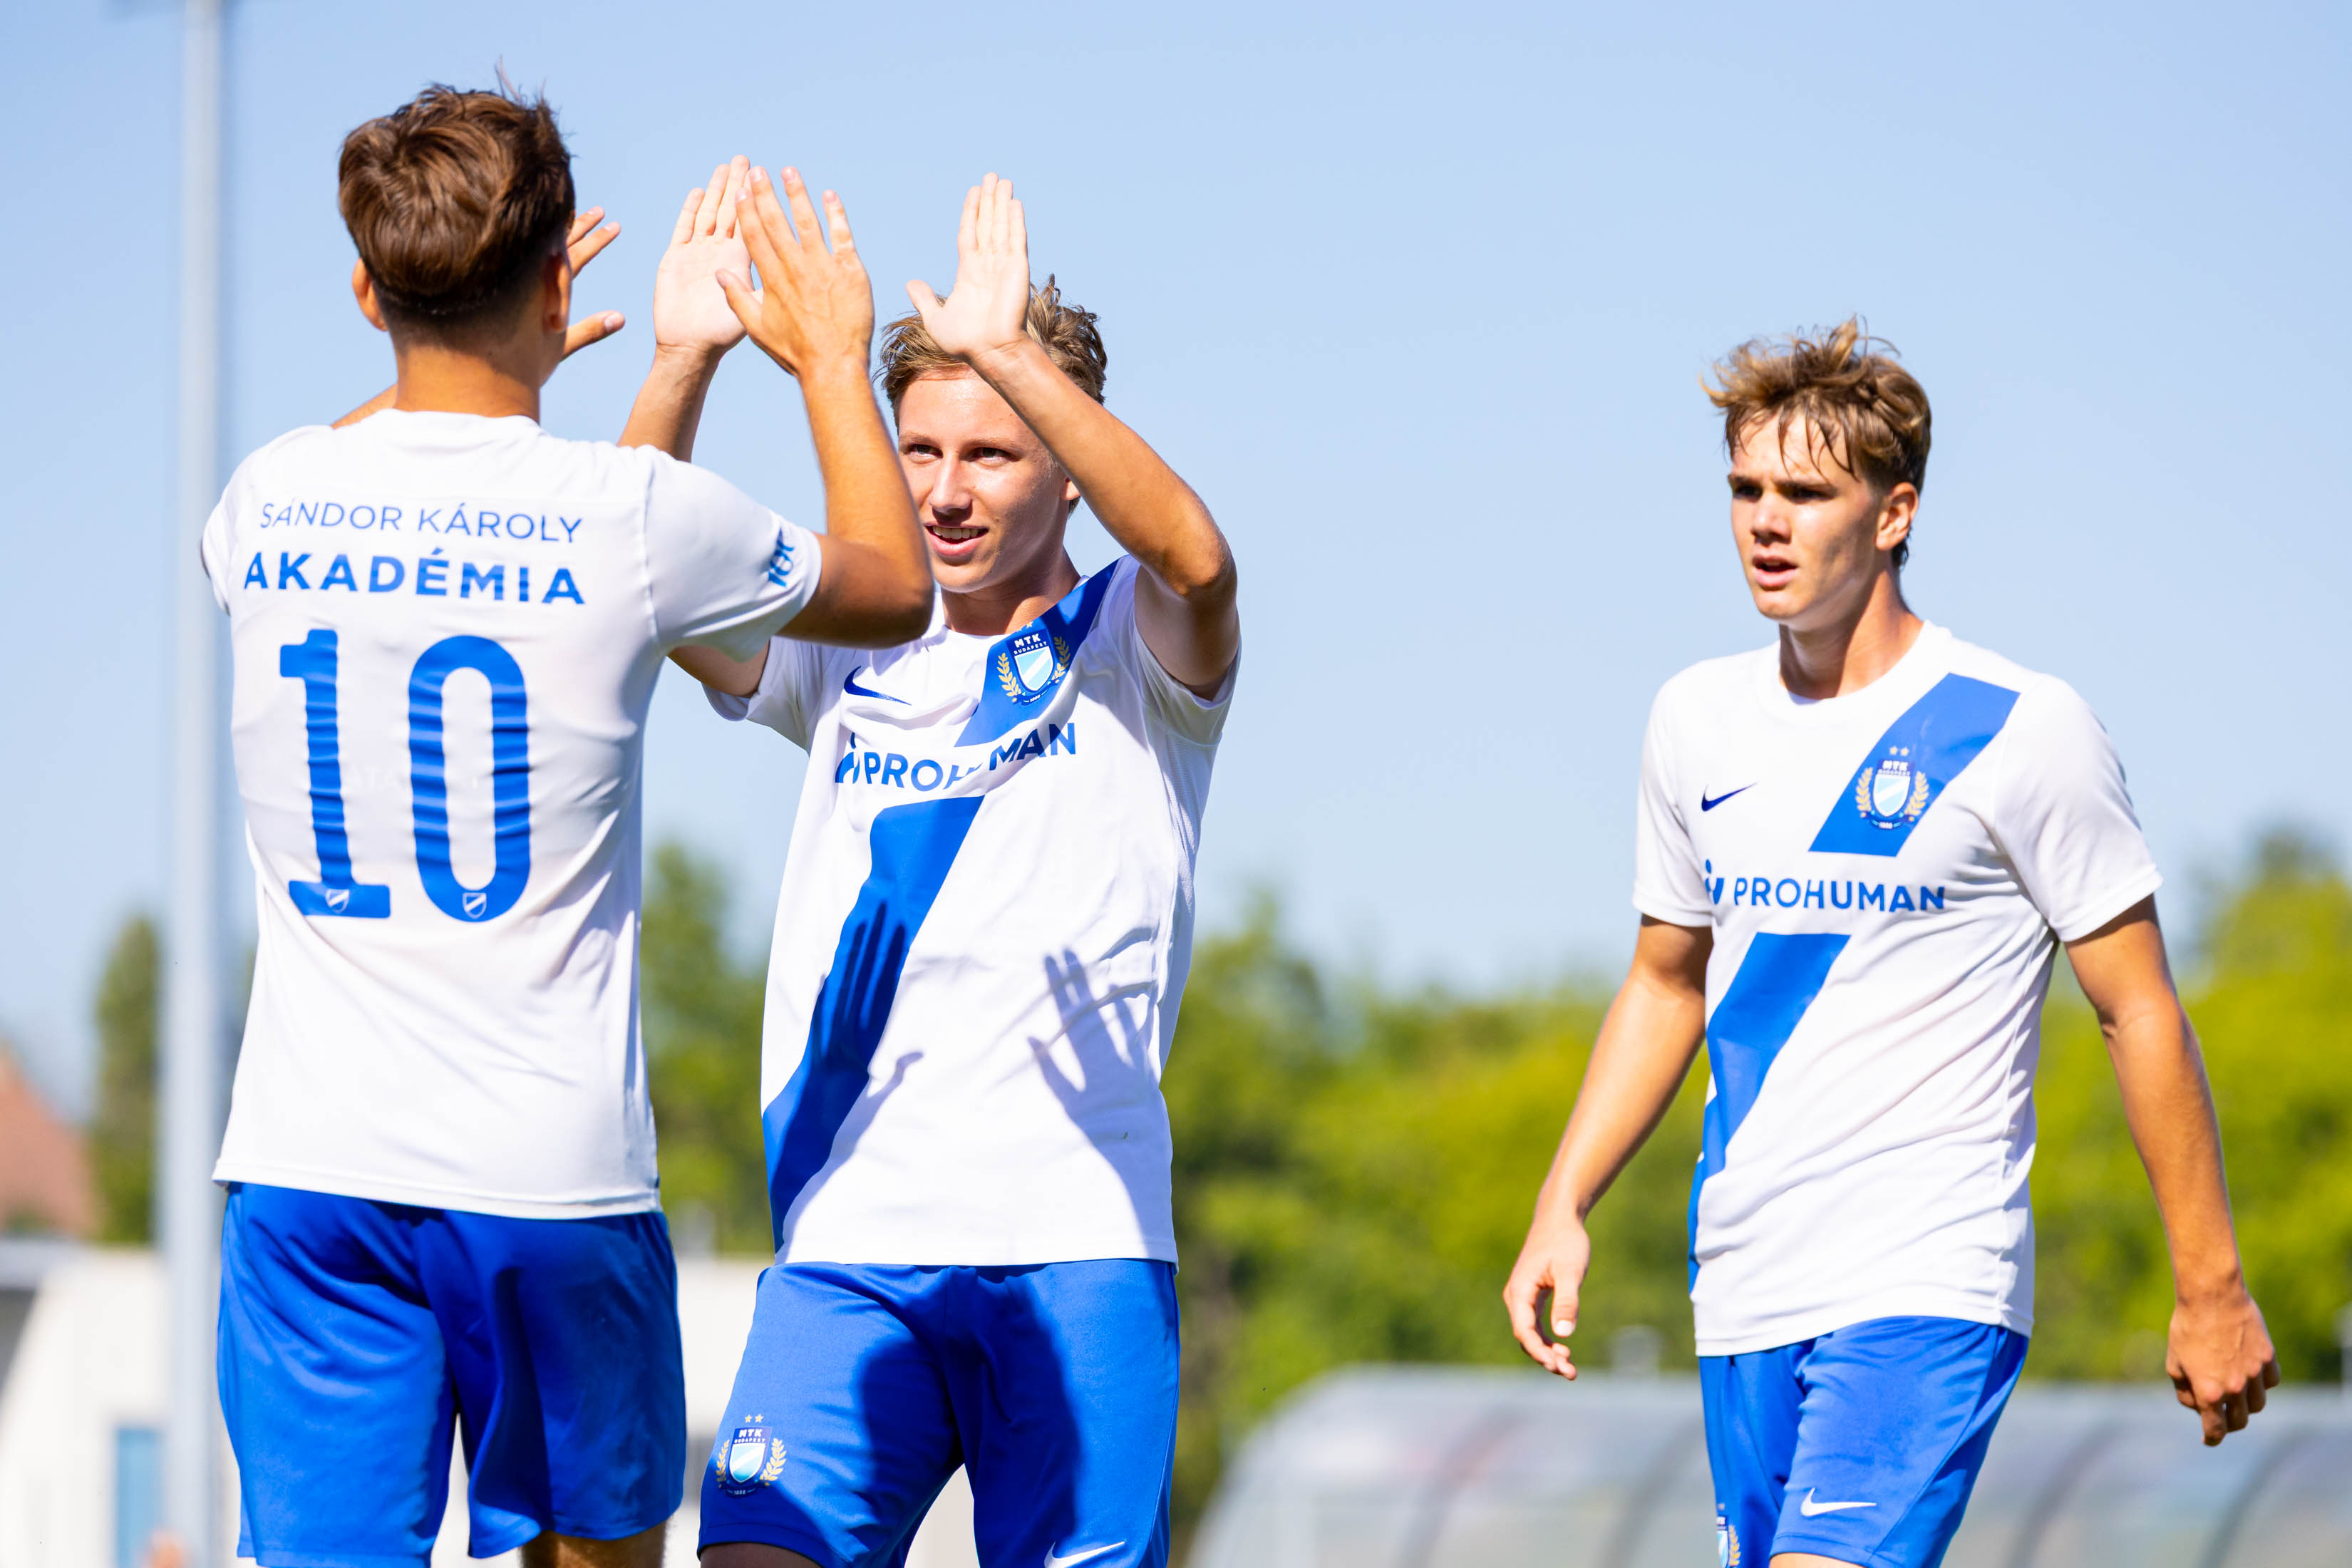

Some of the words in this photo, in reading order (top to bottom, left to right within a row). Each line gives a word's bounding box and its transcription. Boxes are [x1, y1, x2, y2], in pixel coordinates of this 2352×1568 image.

[259, 497, 403, 531] SÁNDOR
[417, 502, 583, 543] KÁROLY
[243, 547, 586, 604] AKADÉMIA
[1013, 633, 1042, 648] MTK
[1013, 641, 1048, 654] BUDAPEST
[279, 628, 532, 923] 10
[863, 723, 1076, 792] PROHMAN
[1733, 877, 1946, 913] PROHUMAN
[738, 1428, 763, 1438] MTK
